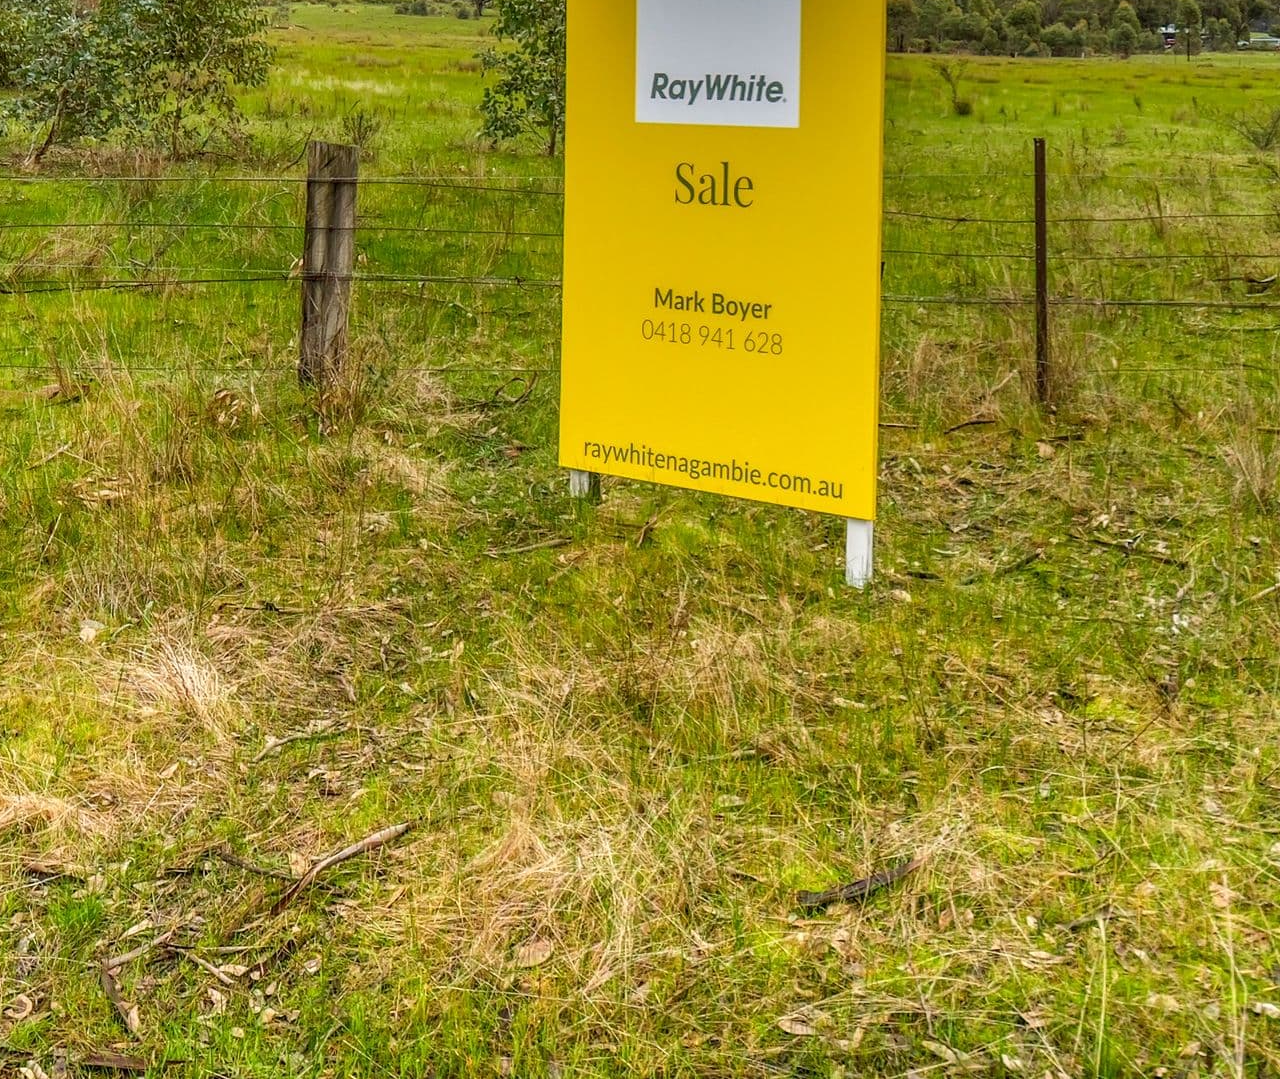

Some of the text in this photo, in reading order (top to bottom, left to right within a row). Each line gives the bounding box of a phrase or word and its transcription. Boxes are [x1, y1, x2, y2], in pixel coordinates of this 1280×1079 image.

[675, 162, 754, 208] Sale
[654, 287, 772, 322] Mark Boyer
[641, 319, 783, 355] 0418 941 628
[584, 440, 844, 500] raywhitenagambie.com.au
